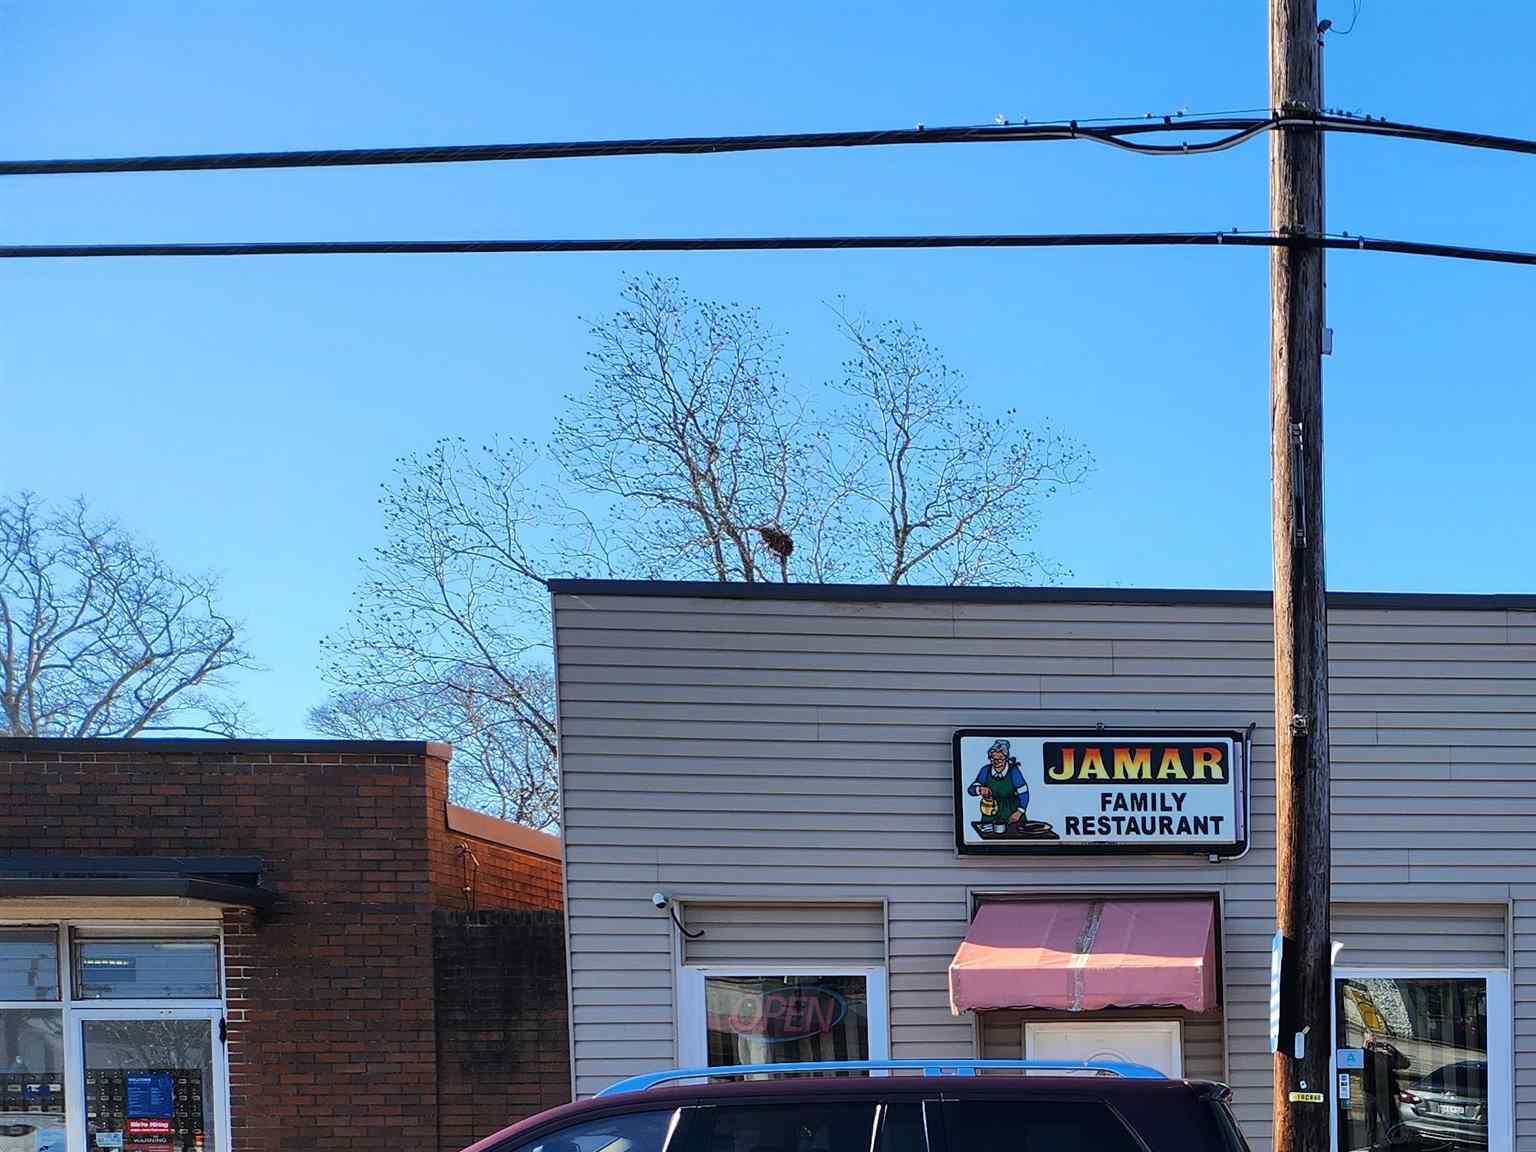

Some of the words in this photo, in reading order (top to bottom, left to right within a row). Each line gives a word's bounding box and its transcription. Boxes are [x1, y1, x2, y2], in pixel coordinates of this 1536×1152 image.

[1048, 746, 1226, 781] JAMAR
[1100, 792, 1188, 812] FAMILY
[1065, 815, 1225, 836] RESTAURANT
[729, 994, 836, 1034] OPEN
